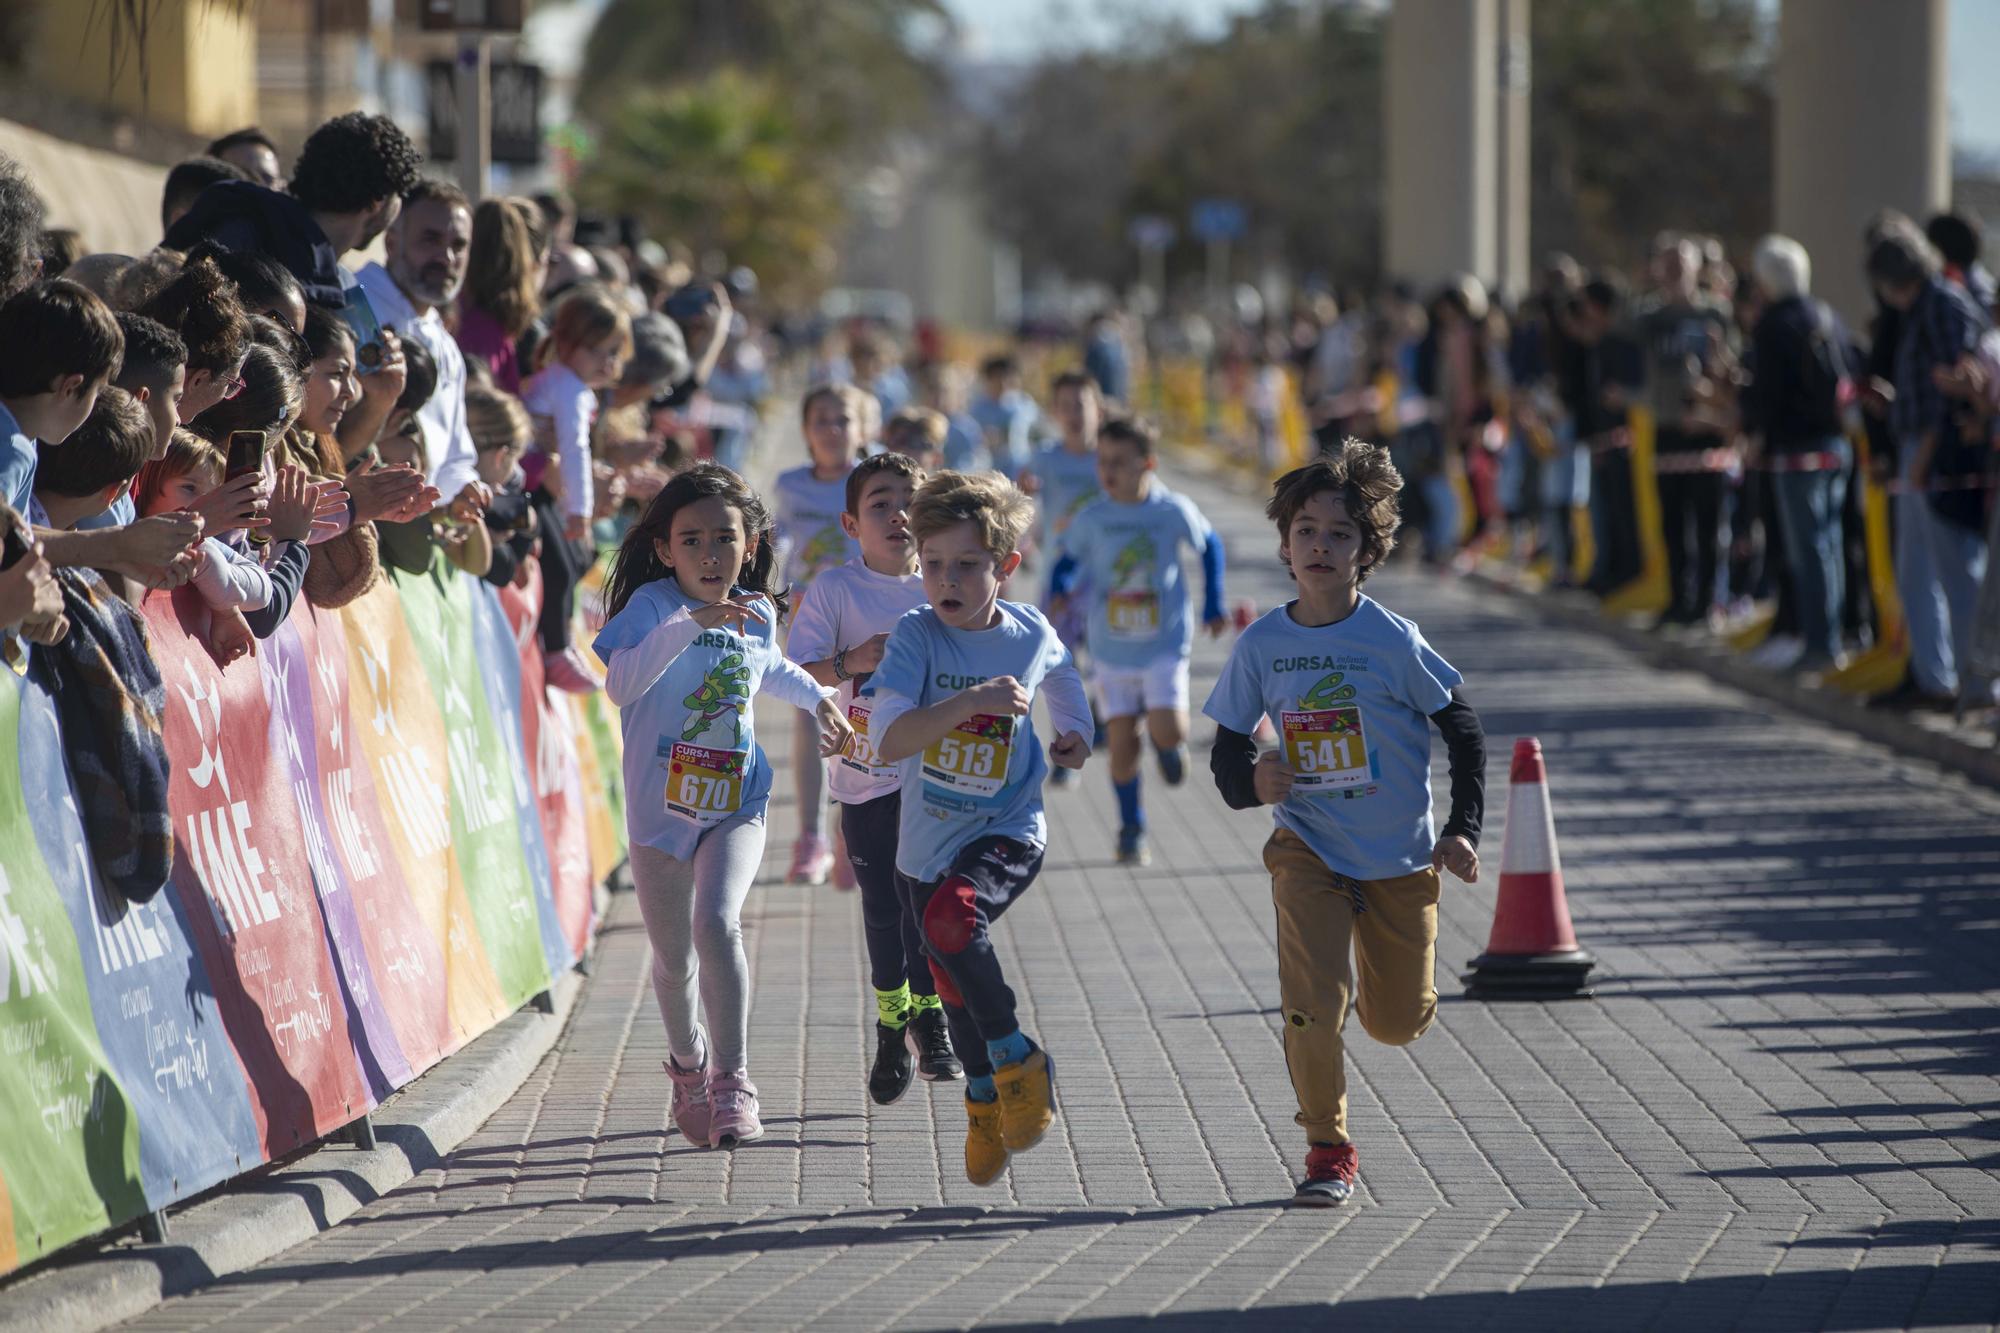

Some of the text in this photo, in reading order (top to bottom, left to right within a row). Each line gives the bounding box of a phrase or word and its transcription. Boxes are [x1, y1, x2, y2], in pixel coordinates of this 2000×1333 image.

[1273, 656, 1335, 673] CURSA
[936, 673, 988, 690] CUR
[852, 707, 869, 720] CUR
[1284, 714, 1315, 723] CURSA
[1285, 722, 1303, 730] 2023
[675, 753, 696, 763] 2023
[677, 745, 710, 759] CURSA
[938, 737, 995, 777] 513
[1296, 737, 1352, 772] 541
[680, 774, 731, 810] 670
[187, 800, 281, 937] IME
